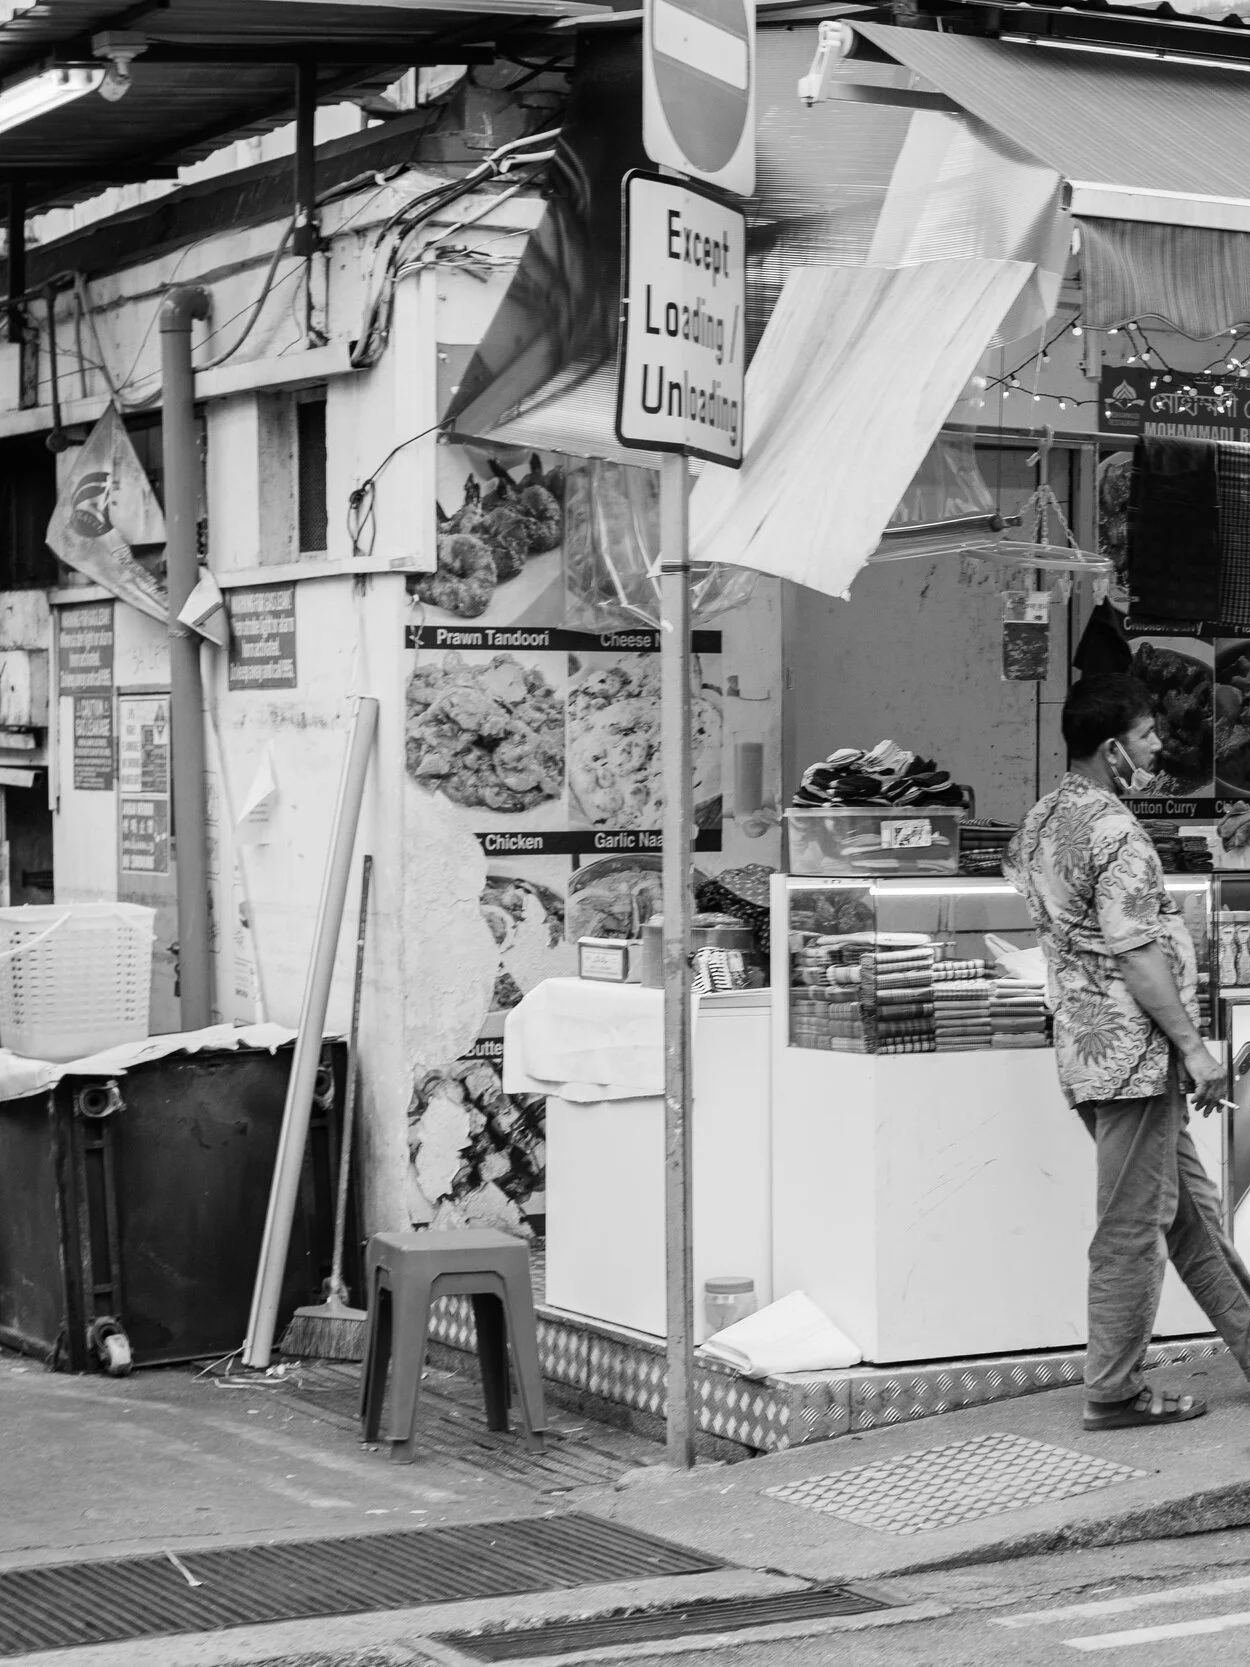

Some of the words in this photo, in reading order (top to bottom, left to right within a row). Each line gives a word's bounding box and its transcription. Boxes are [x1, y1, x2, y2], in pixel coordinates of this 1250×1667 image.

[668, 209, 729, 286] Except
[646, 284, 724, 365] Loading
[642, 364, 738, 446] Unloading
[436, 630, 482, 646] Prawn
[487, 630, 549, 646] Tandoori
[600, 632, 652, 648] Cheese
[1165, 801, 1197, 817] Curry
[485, 834, 543, 850] Chicken
[594, 832, 636, 848] Garlic
[639, 831, 664, 848] Naa
